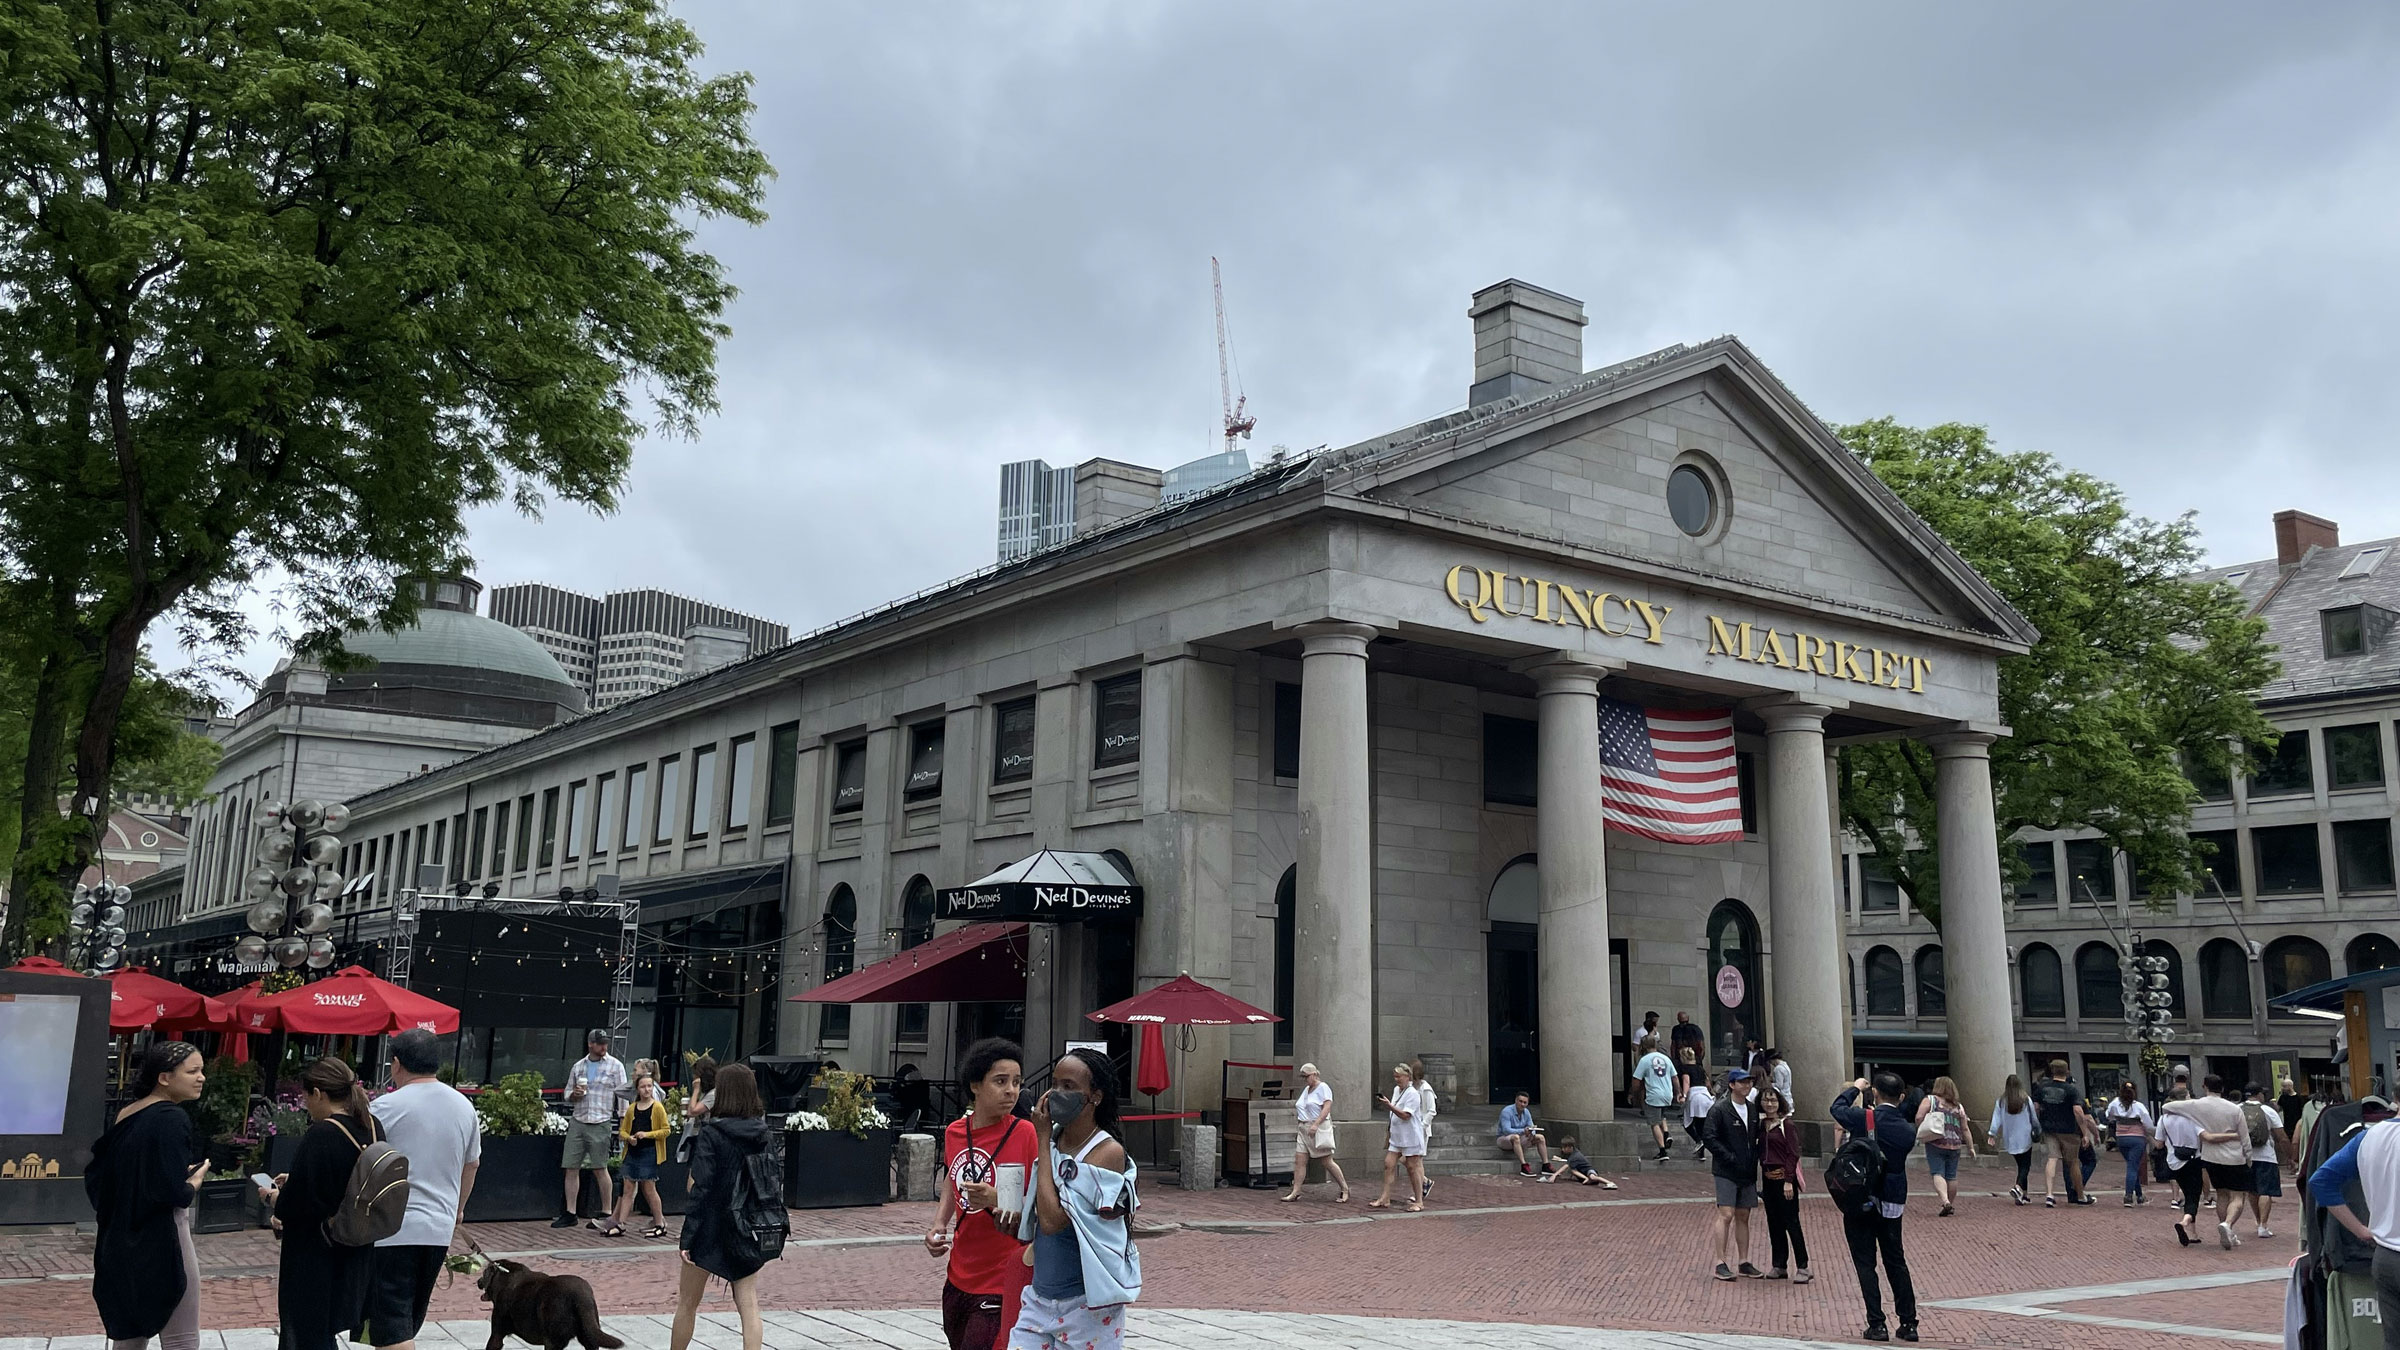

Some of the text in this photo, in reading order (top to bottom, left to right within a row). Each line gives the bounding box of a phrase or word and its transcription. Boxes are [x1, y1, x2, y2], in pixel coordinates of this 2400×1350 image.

[1445, 564, 1932, 693] QUINCY MARKET
[947, 890, 967, 915] Ned
[1033, 887, 1069, 910] Ned
[1127, 1014, 1167, 1023] HARPOON
[950, 1153, 968, 1181] JUNIOR
